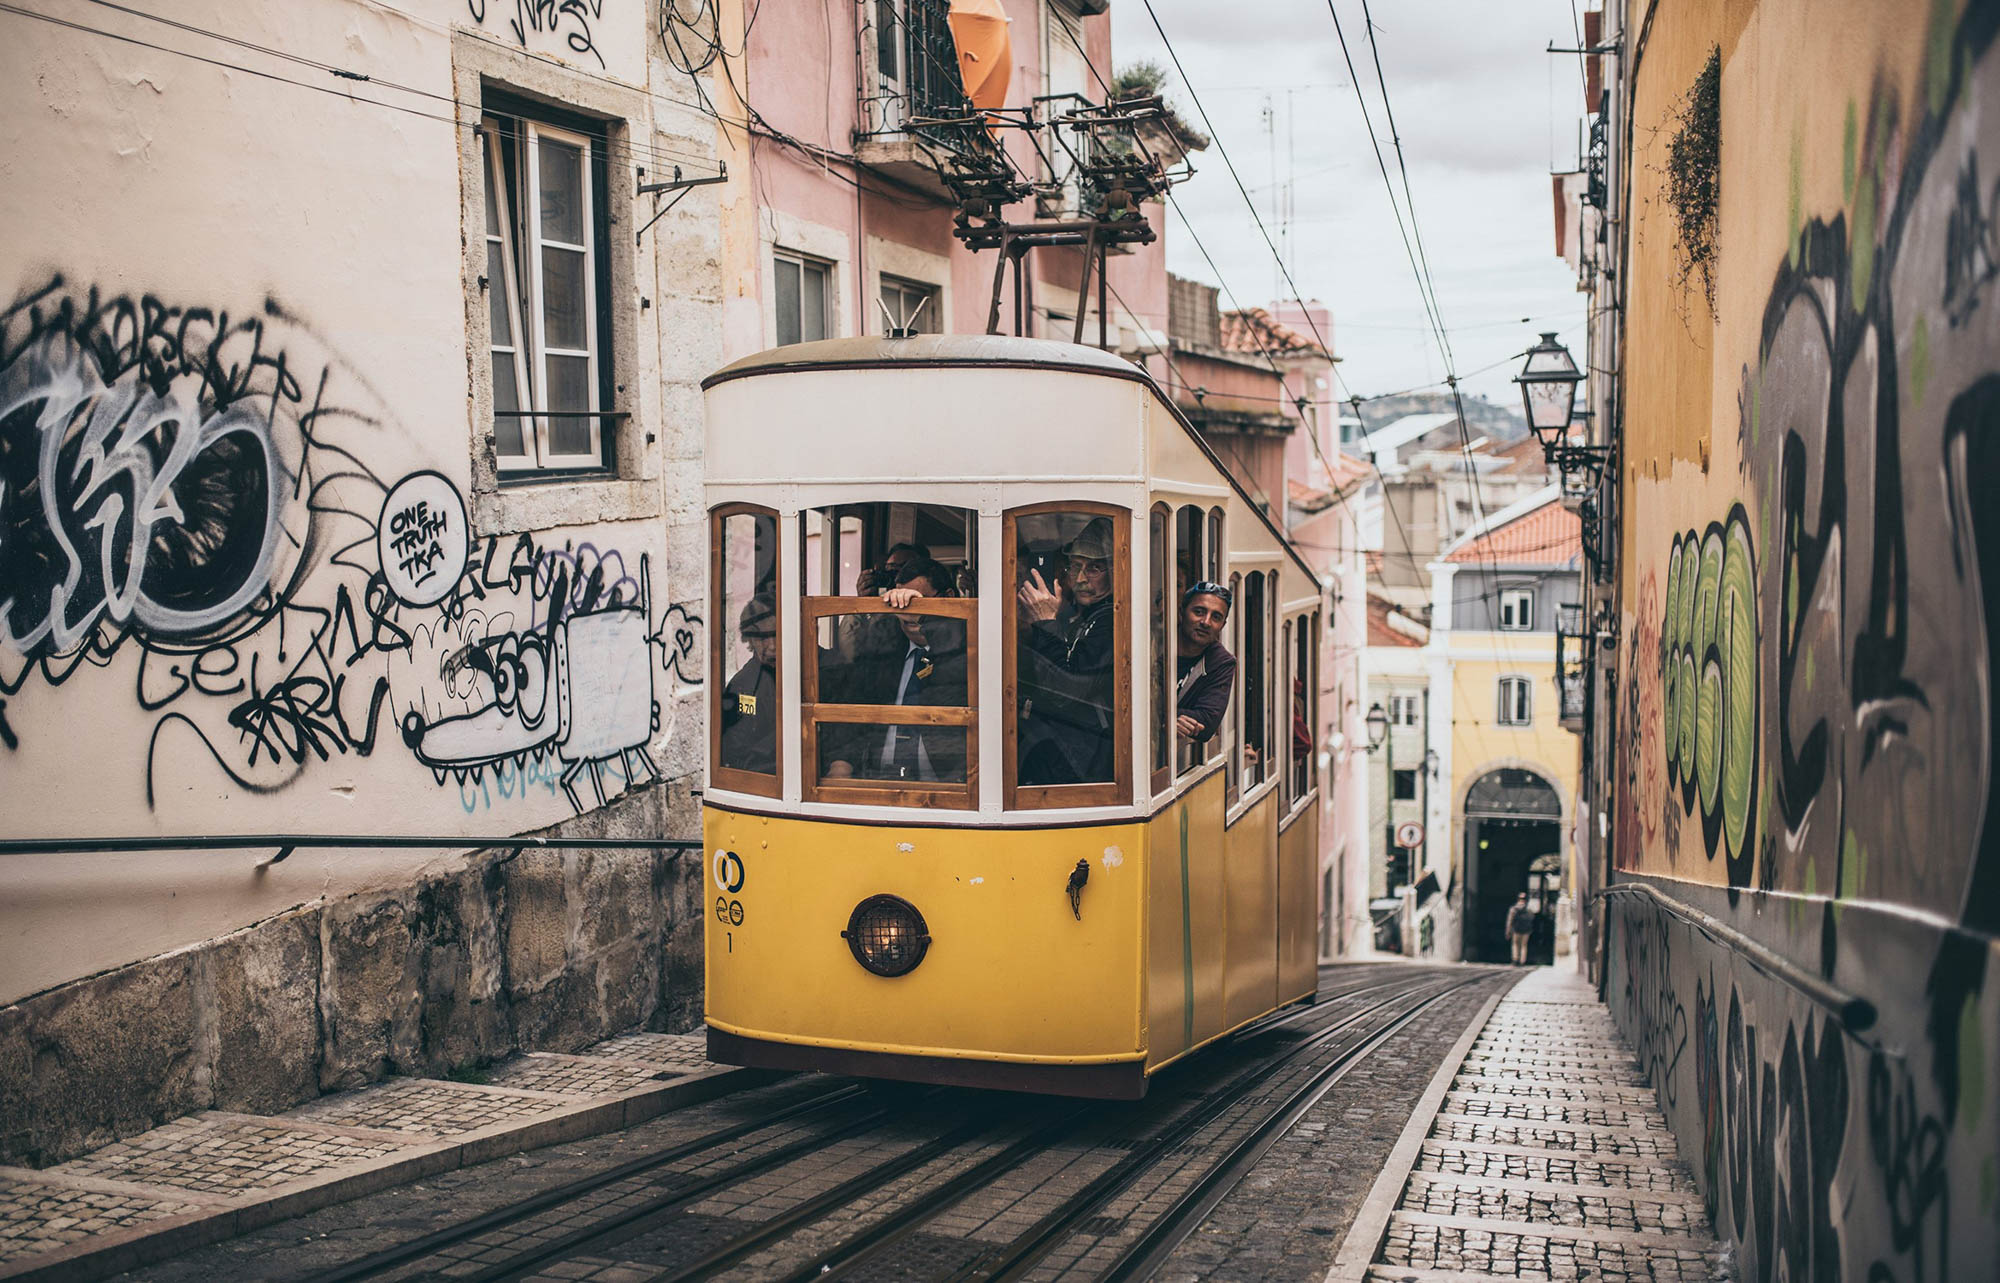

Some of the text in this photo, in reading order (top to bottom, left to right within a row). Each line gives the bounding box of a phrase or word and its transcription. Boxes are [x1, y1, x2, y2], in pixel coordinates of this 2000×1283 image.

[390, 501, 428, 534] ONE
[390, 510, 447, 558] TRUTH
[399, 541, 445, 580] TKA
[727, 932, 732, 953] 1
